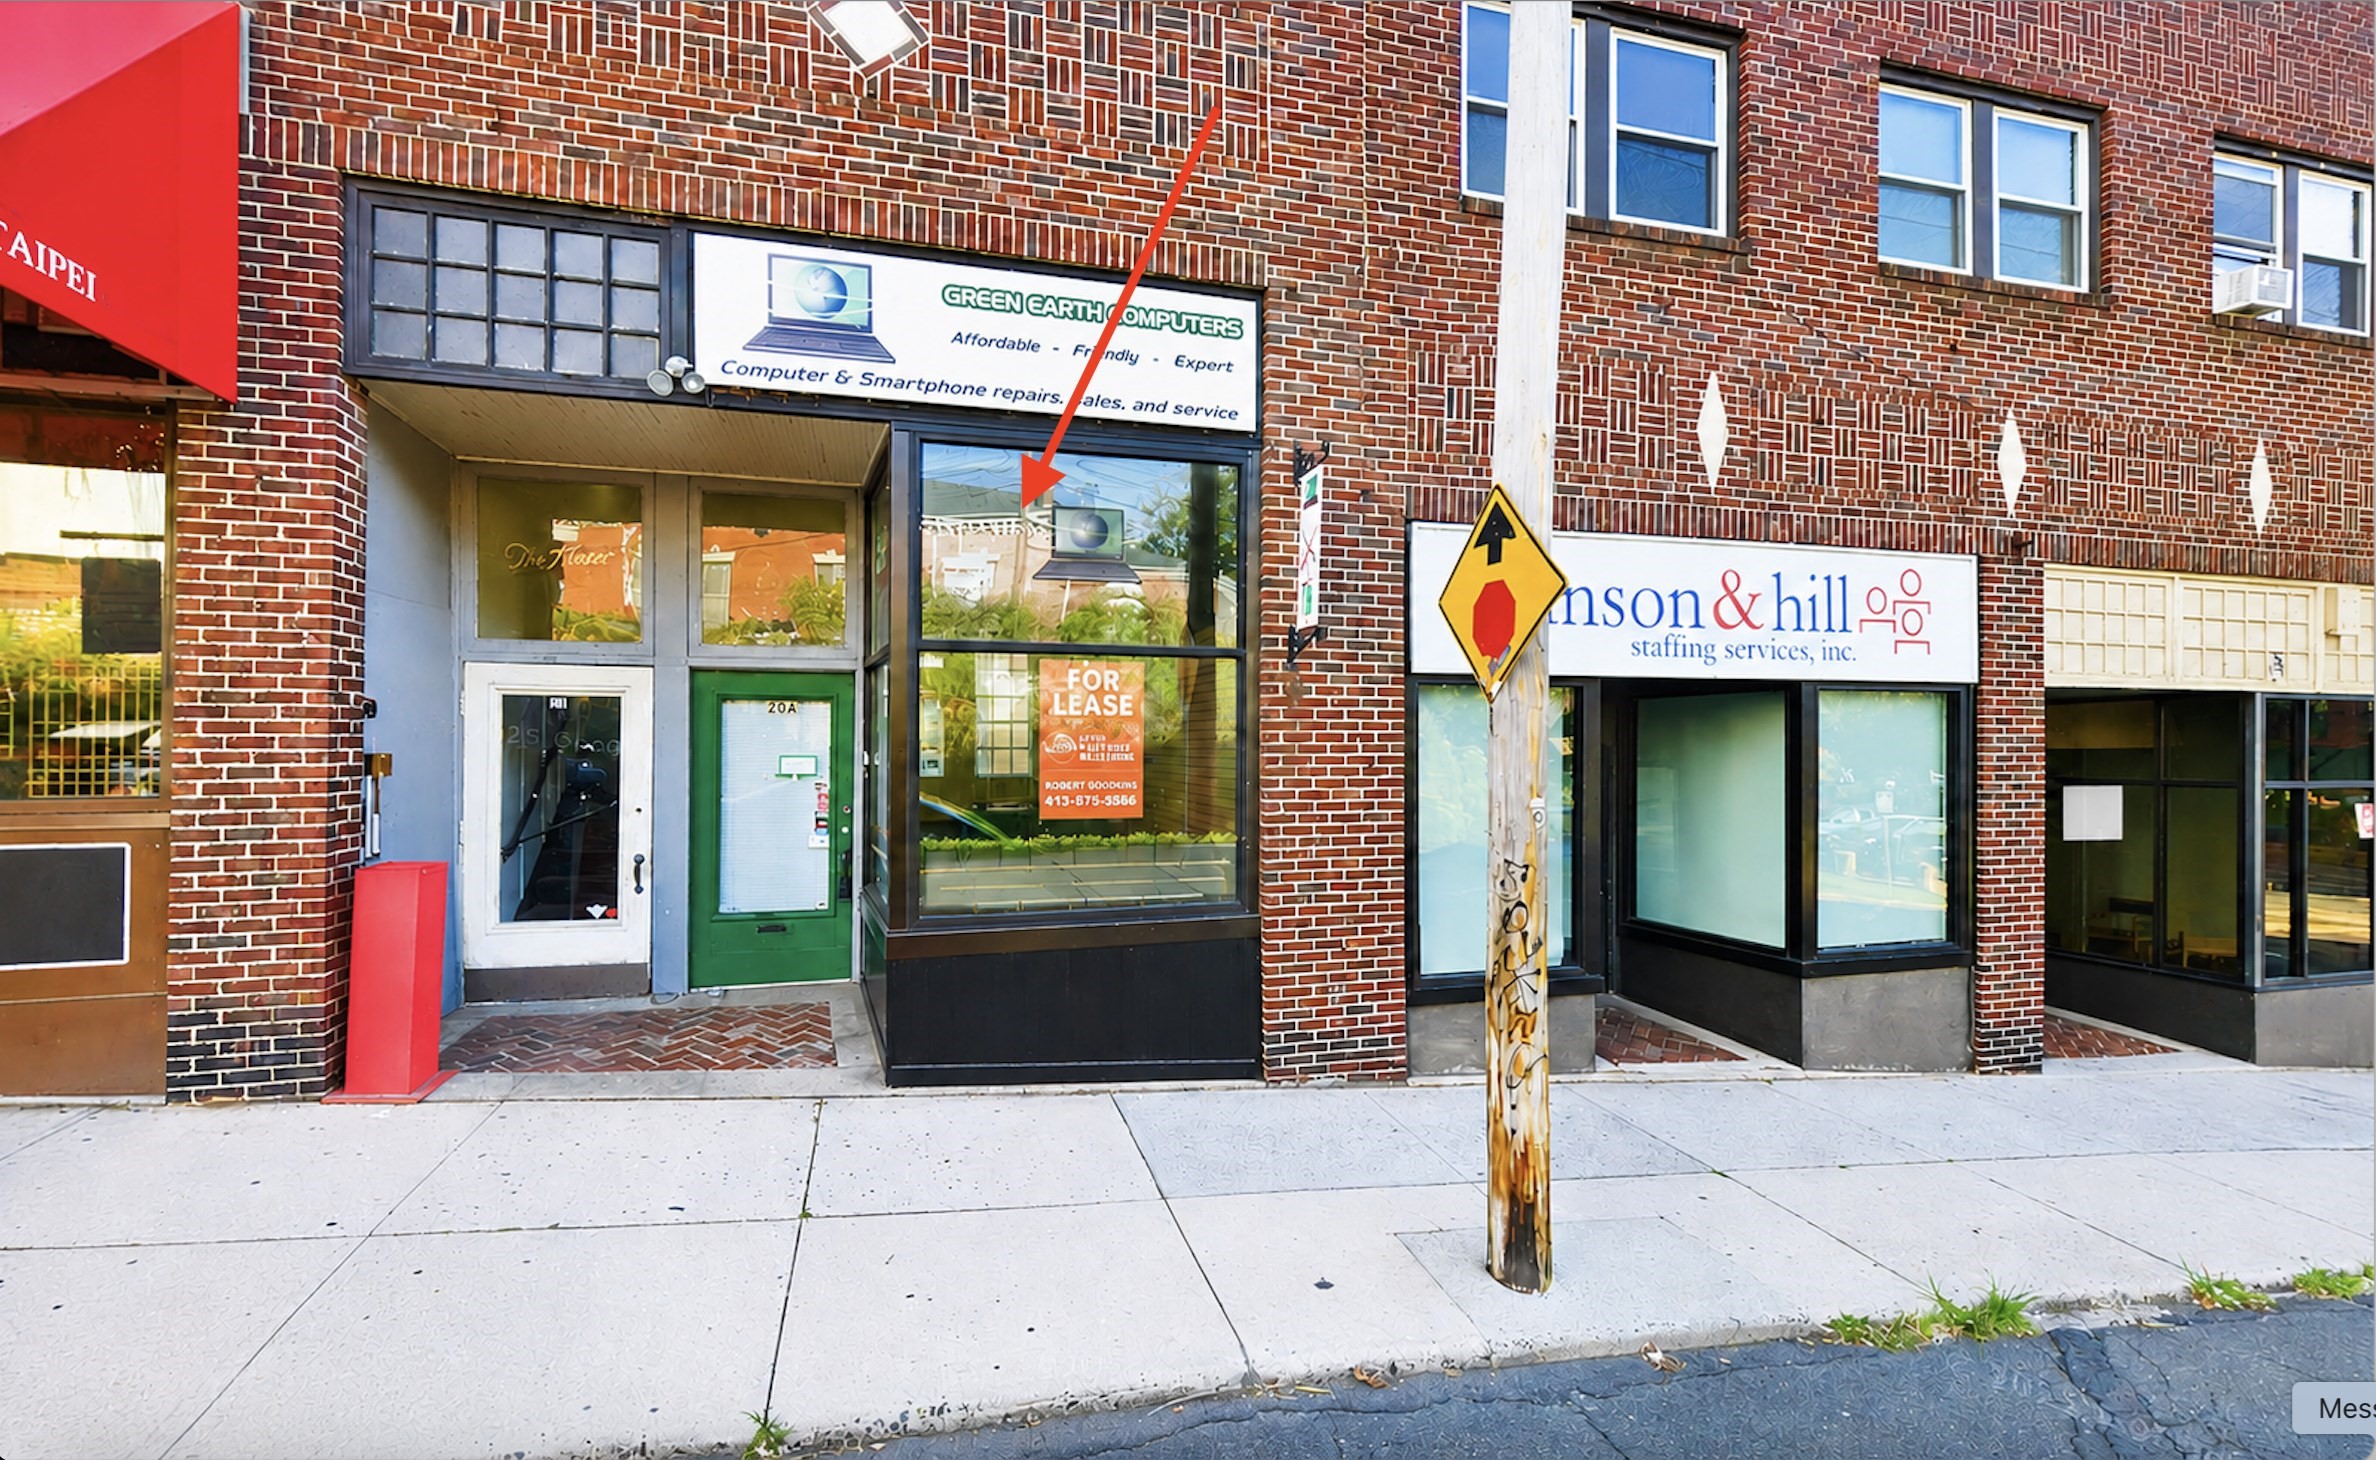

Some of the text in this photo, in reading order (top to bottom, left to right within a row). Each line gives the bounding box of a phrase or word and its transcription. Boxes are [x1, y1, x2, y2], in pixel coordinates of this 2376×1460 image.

[942, 284, 1023, 314] GREEN
[1027, 294, 1104, 323] EARTH
[951, 331, 1041, 353] Affordable
[1174, 355, 1235, 373] Expert
[720, 360, 829, 383] Computer
[835, 370, 853, 385] &
[859, 372, 987, 397] Smartphone
[1132, 400, 1167, 414] and
[1173, 403, 1239, 421] service
[1631, 633, 1857, 666] staffing services, inc.
[1068, 669, 1120, 691] FOR
[768, 702, 797, 714] 20A
[1053, 693, 1134, 716] LEASE
